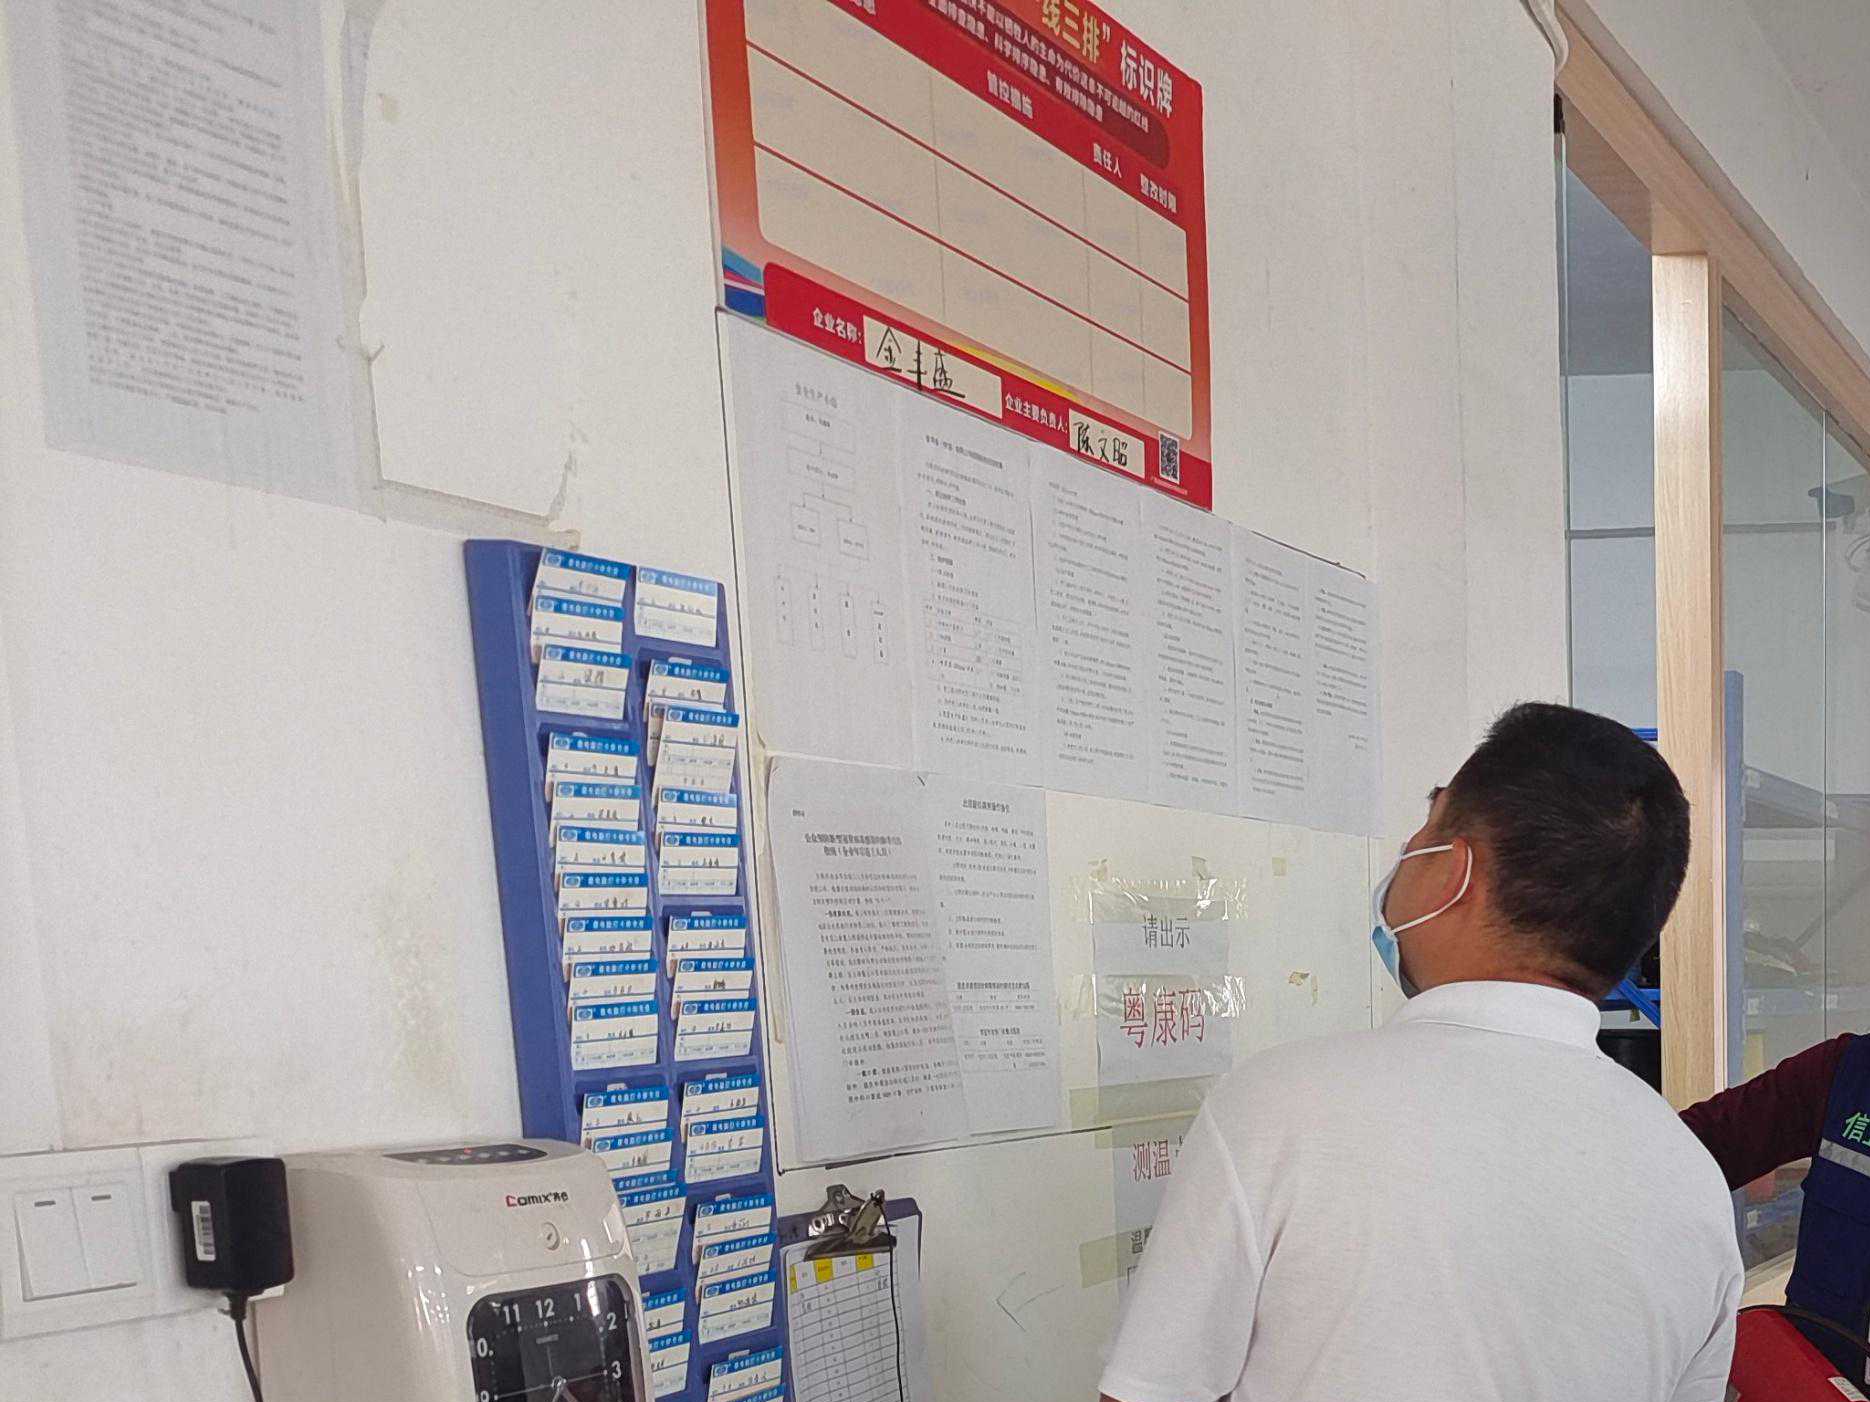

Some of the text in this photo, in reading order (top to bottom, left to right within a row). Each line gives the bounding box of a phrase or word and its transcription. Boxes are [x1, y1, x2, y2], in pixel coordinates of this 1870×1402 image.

[1142, 914, 1191, 950] 请出示
[1120, 987, 1206, 1049] 粤康码
[503, 1303, 521, 1325] 11
[535, 1298, 555, 1319] 12
[606, 1312, 618, 1331] 2
[611, 1360, 623, 1380] 3
